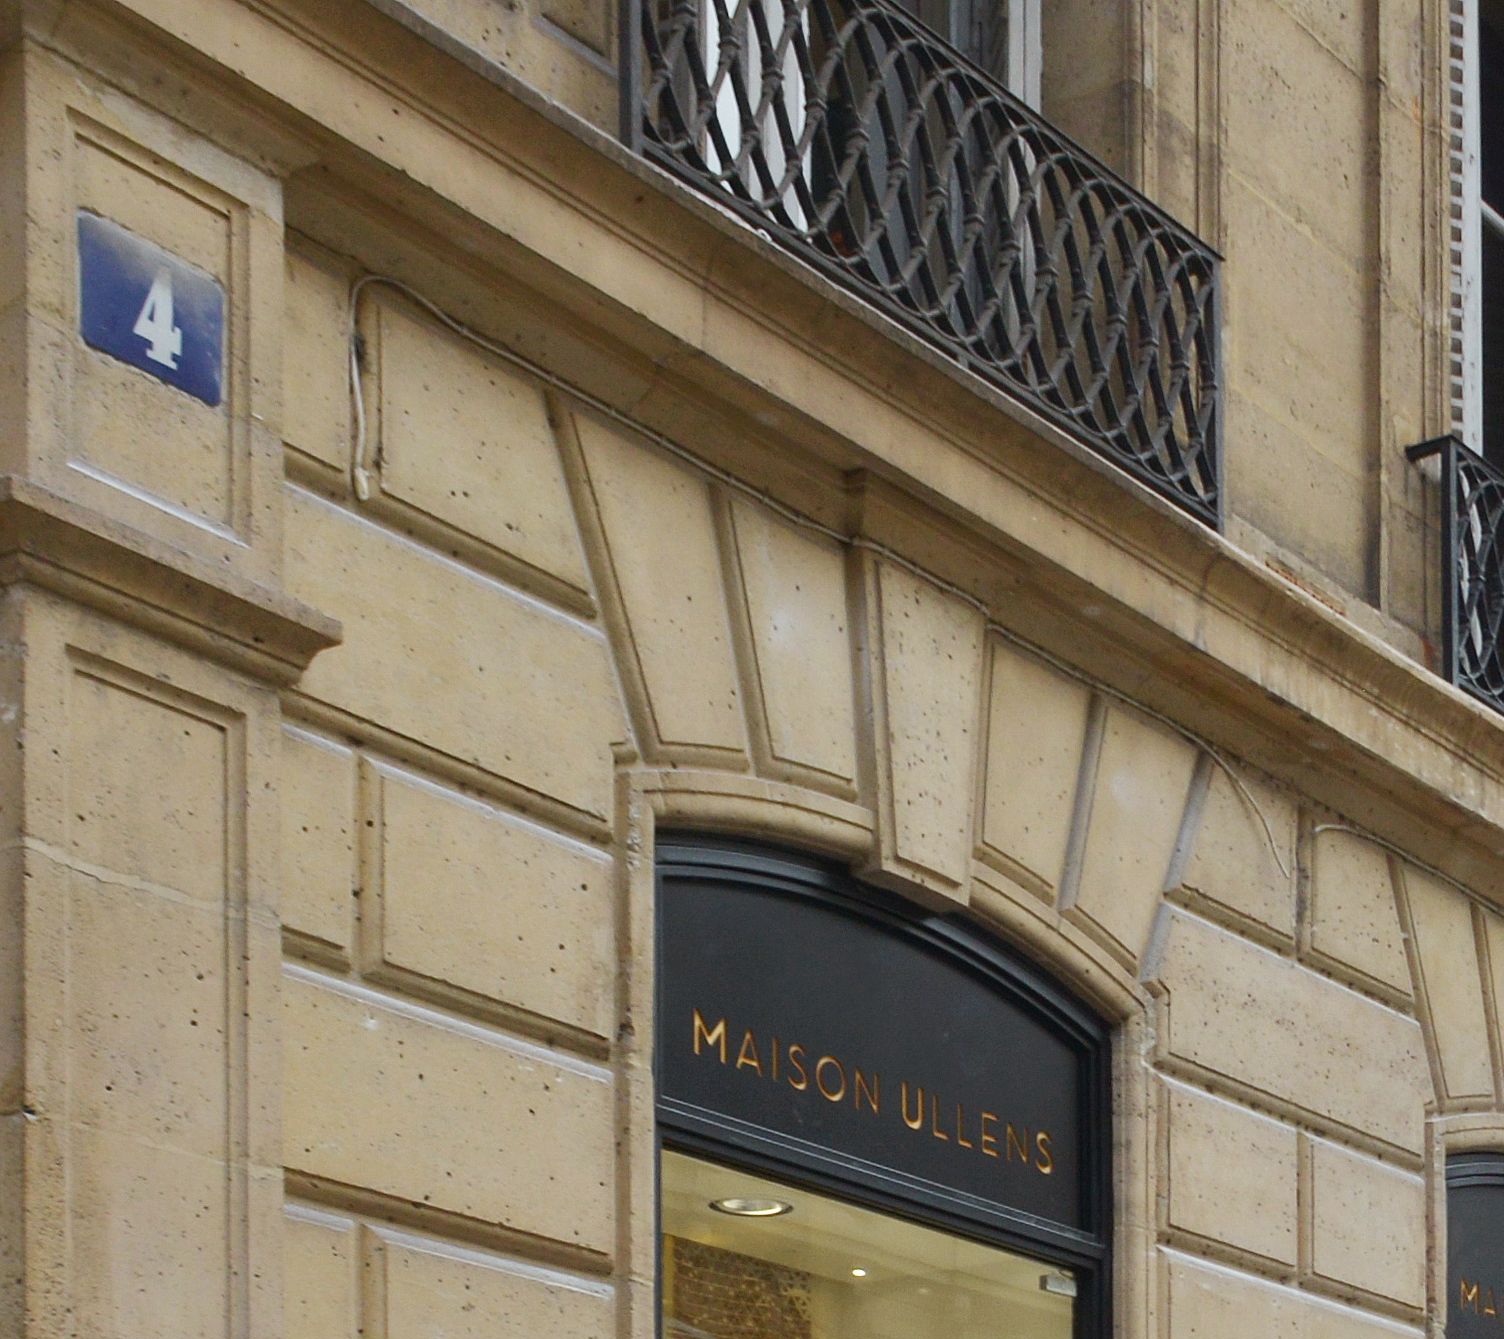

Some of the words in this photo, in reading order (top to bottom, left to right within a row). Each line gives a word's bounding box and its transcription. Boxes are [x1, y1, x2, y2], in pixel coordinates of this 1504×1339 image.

[132, 267, 182, 371] 4
[692, 1008, 881, 1114] MAISON
[901, 1081, 1055, 1175] ULLENS
